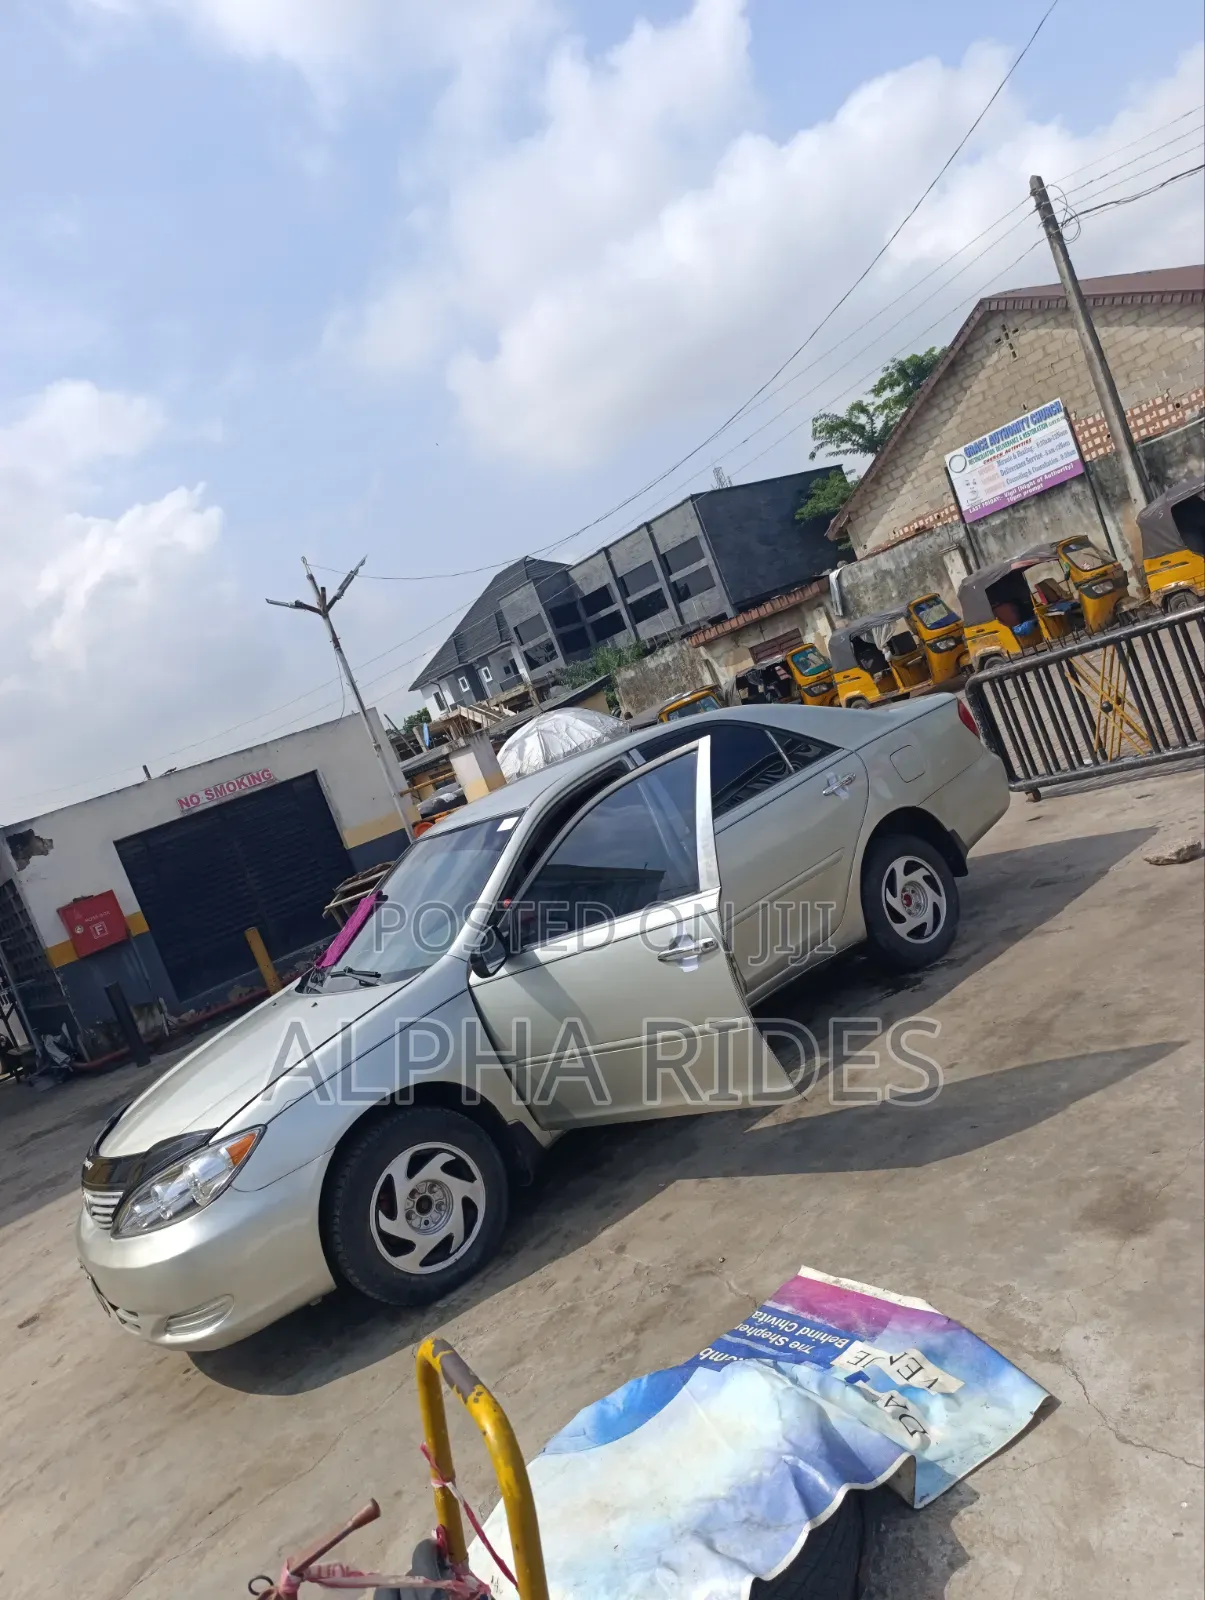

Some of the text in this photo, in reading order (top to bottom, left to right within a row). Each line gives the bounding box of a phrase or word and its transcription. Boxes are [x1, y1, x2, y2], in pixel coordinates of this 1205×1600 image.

[964, 438, 989, 458] GRACE
[988, 416, 1030, 445] AUTHORITY
[1030, 400, 1062, 425] CHURCH
[177, 768, 274, 810] NO SMOKING
[751, 1310, 850, 1349] Behind Chivita
